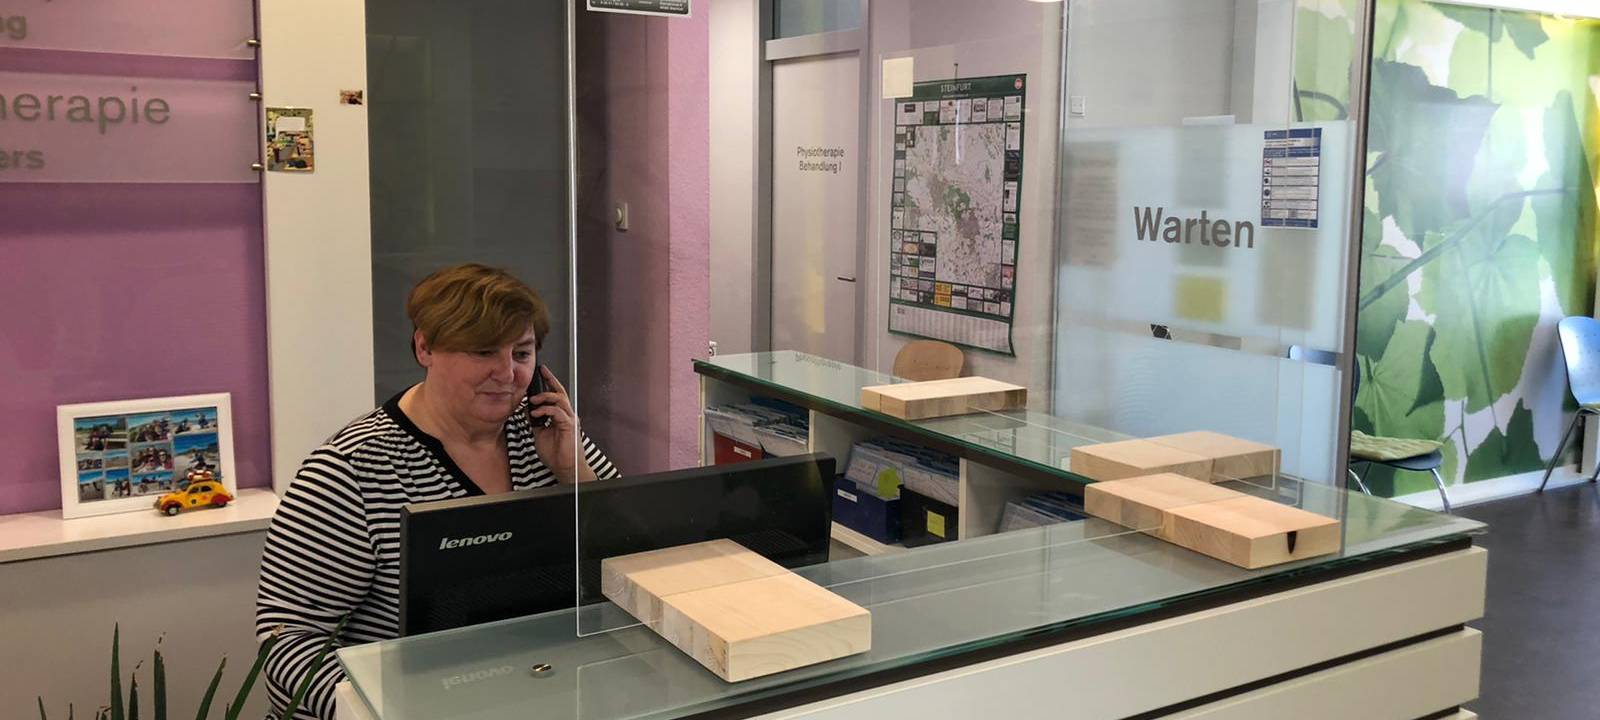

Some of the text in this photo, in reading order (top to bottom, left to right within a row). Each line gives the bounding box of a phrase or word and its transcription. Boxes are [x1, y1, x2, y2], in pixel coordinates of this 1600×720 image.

[0, 86, 171, 135] erapie
[797, 146, 844, 159] Physiotherapie
[799, 160, 837, 174] Behandlung
[1134, 206, 1255, 249] Warten
[439, 531, 513, 550] lenovo
